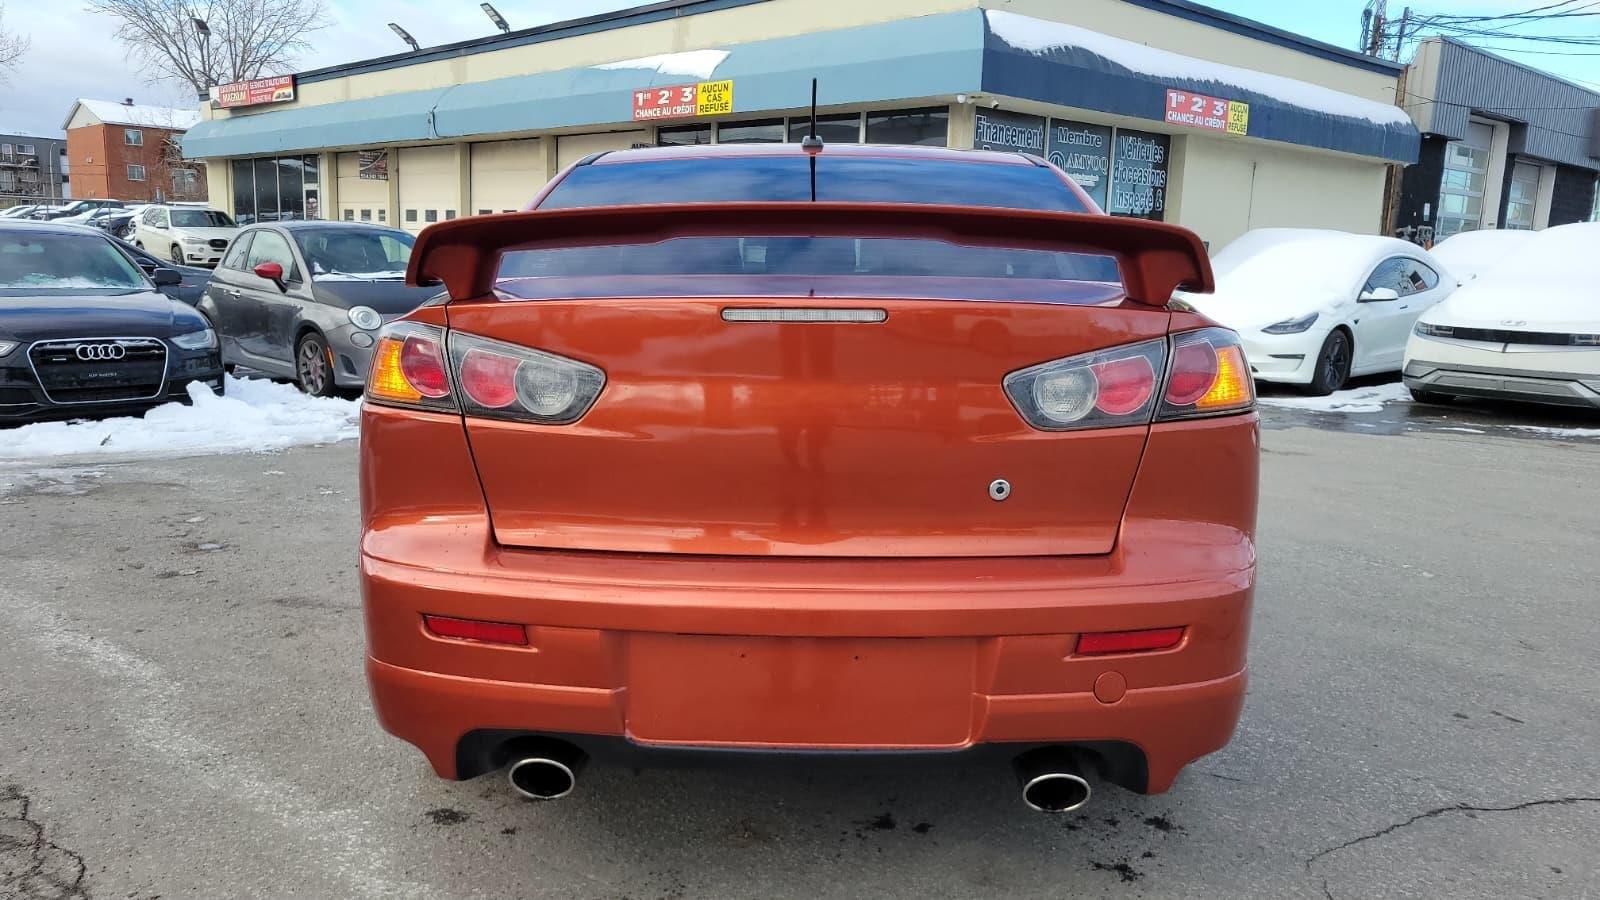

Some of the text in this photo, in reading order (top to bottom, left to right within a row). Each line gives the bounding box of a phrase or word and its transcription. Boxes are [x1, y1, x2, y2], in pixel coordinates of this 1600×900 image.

[701, 83, 729, 94] AUCUN
[706, 93, 722, 103] CAS
[635, 104, 696, 118] CHANCE AU CRÉDIT
[699, 100, 729, 113] REFUSÉ
[1230, 103, 1248, 114] AUCUN
[1167, 110, 1226, 129] CHANCE AU CRÉDIT
[1232, 113, 1244, 122] CAS
[975, 114, 1044, 150] Financement
[1057, 126, 1103, 148] Membre
[1120, 135, 1165, 164] Véhicules
[1065, 152, 1109, 176] AMVOQ
[1114, 159, 1166, 188] d'occasions
[1114, 185, 1163, 215] inspecté &
